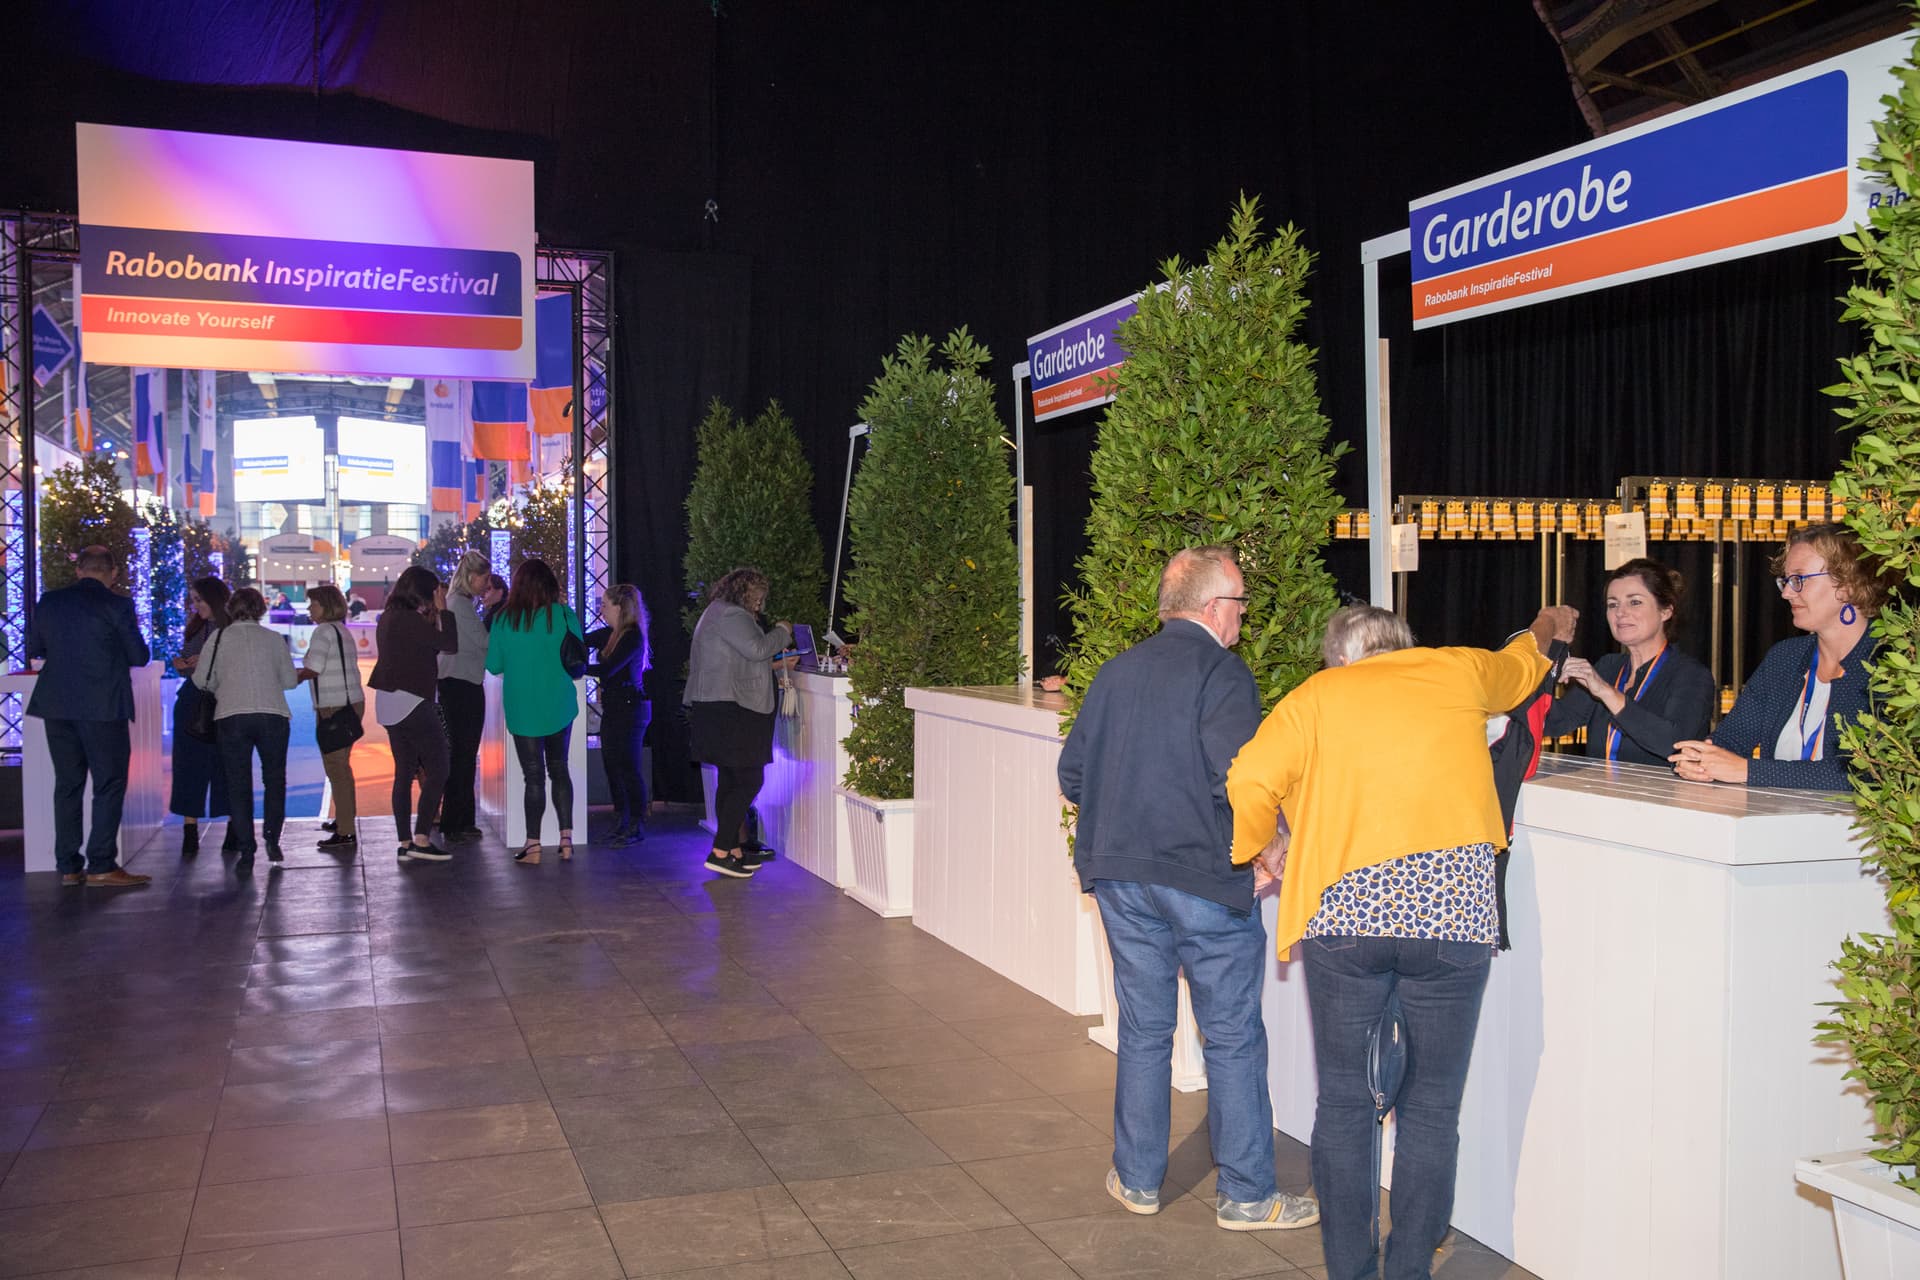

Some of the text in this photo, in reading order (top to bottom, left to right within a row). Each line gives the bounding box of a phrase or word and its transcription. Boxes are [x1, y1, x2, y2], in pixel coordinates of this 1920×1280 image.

[1423, 164, 1632, 264] Garderobe
[105, 250, 499, 297] Rabobank InspiratieFestival
[1424, 263, 1553, 307] Rabobank InspiratieFestival
[107, 307, 276, 330] Innovate Yourself
[1034, 327, 1105, 381] Garderobe
